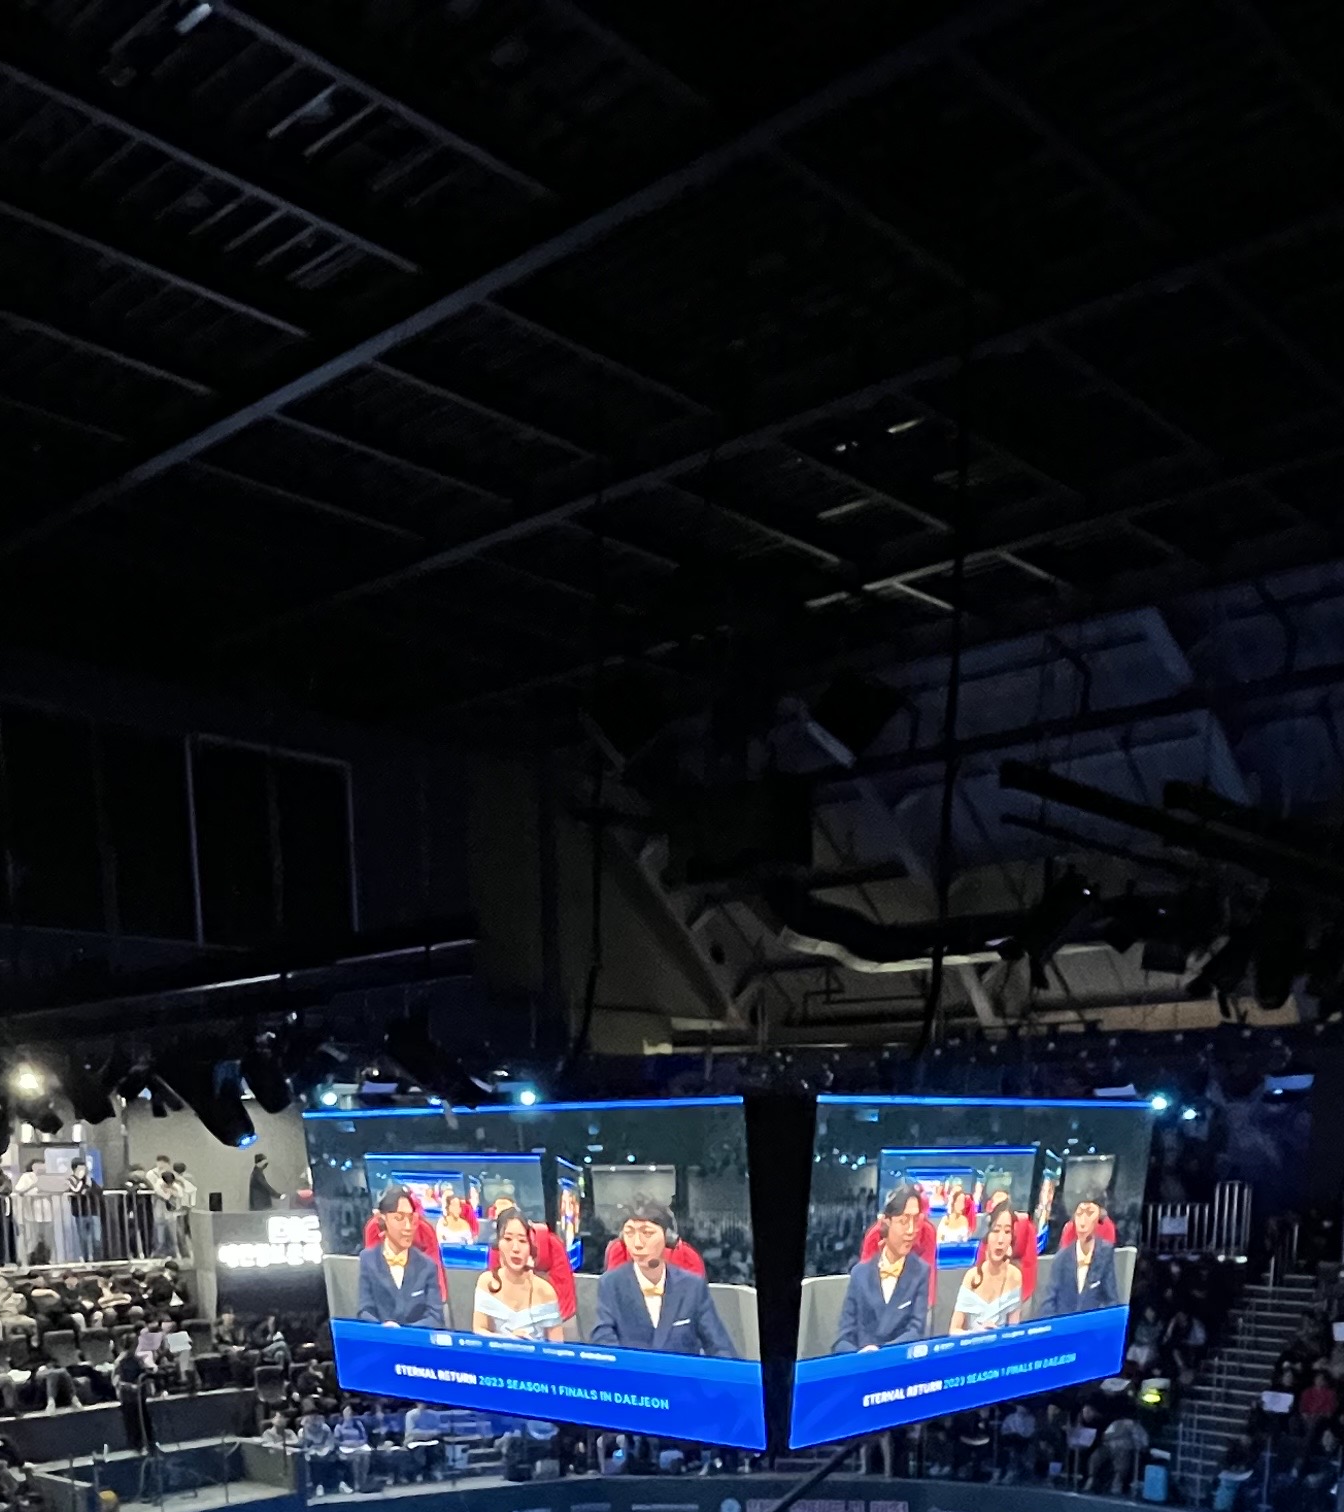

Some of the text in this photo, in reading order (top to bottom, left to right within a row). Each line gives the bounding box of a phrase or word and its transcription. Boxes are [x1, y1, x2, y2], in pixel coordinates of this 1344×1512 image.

[478, 1375, 504, 1388] 2023
[506, 1379, 549, 1394] SEASON
[550, 1384, 557, 1396] 1
[558, 1385, 598, 1401] FINALS
[599, 1390, 612, 1403] IN
[614, 1392, 670, 1410] DAEJEON
